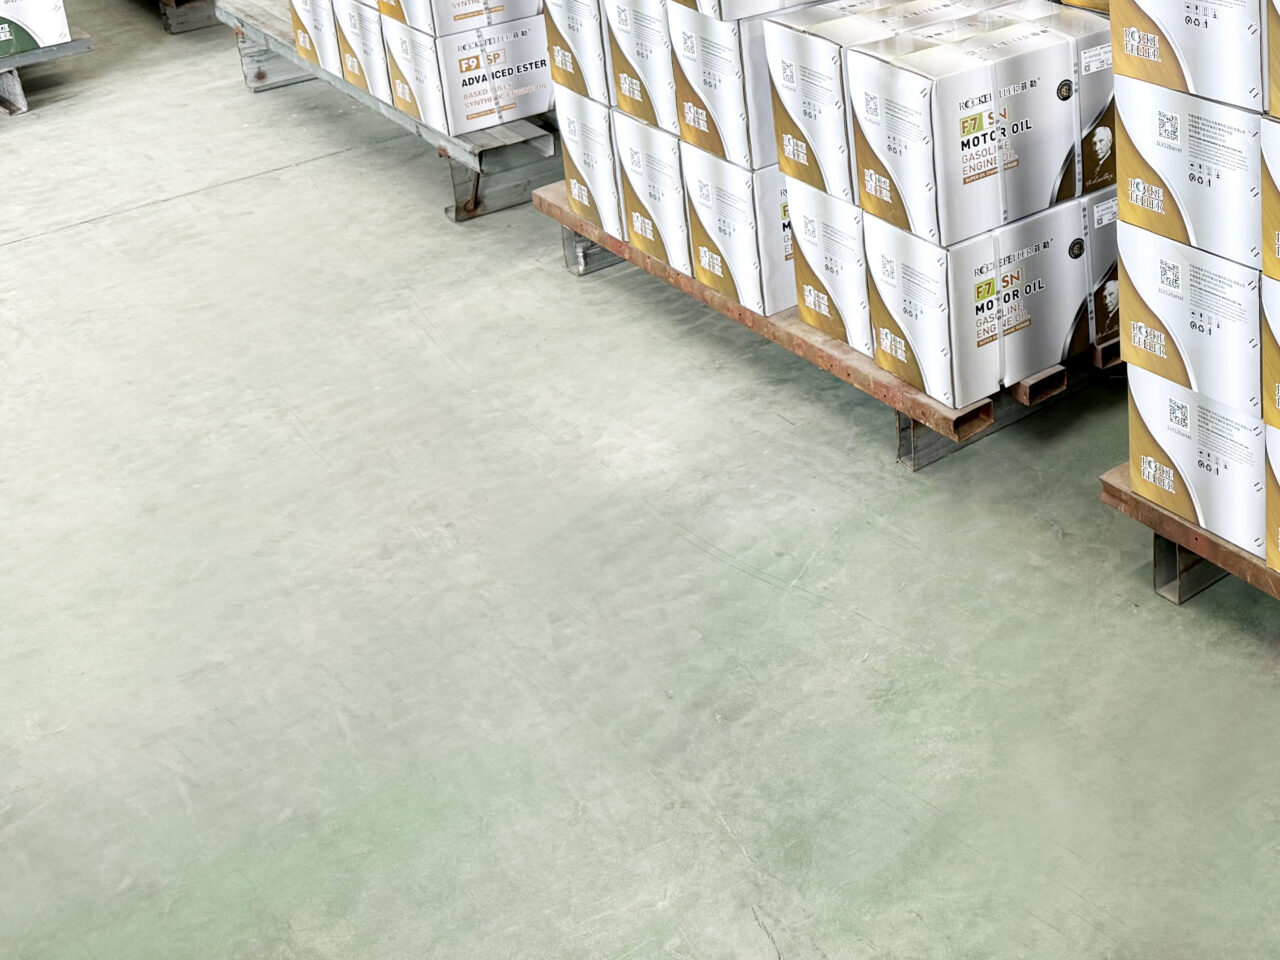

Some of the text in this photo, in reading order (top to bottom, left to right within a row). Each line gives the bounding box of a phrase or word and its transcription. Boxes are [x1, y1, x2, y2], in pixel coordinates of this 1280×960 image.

[462, 58, 478, 72] F9
[517, 59, 547, 74] ESTER
[961, 117, 977, 134] F7
[1012, 119, 1032, 135] OIL
[976, 270, 1021, 299] F7 SN
[975, 279, 1045, 316] MOOR OIL
